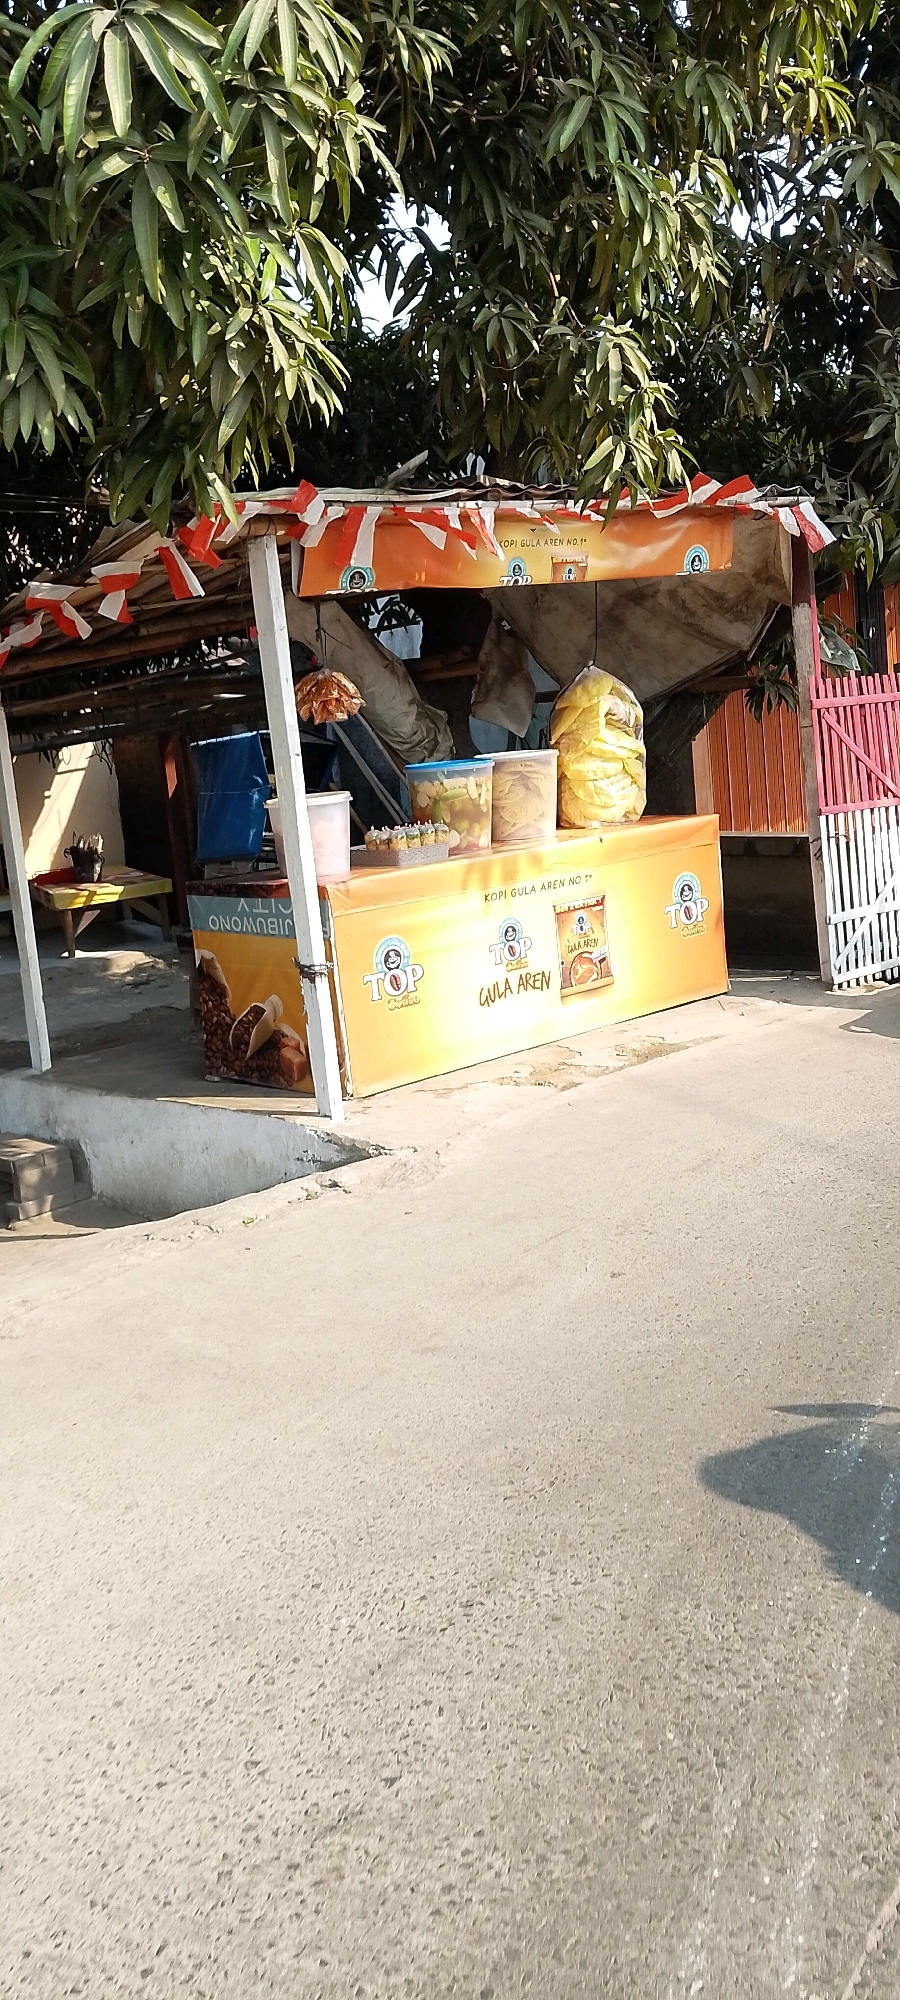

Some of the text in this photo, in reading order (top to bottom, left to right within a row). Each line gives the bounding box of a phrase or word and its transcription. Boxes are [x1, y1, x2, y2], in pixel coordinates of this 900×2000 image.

[520, 538, 541, 548] GULA
[543, 538, 564, 547] AREN
[484, 889, 507, 903] KOPI
[510, 884, 537, 898] GULA
[540, 878, 566, 892] AREN
[664, 897, 710, 929] TOP
[488, 937, 533, 965] TOP
[363, 963, 425, 1002] TOP
[479, 970, 551, 1008] GULA AREN
